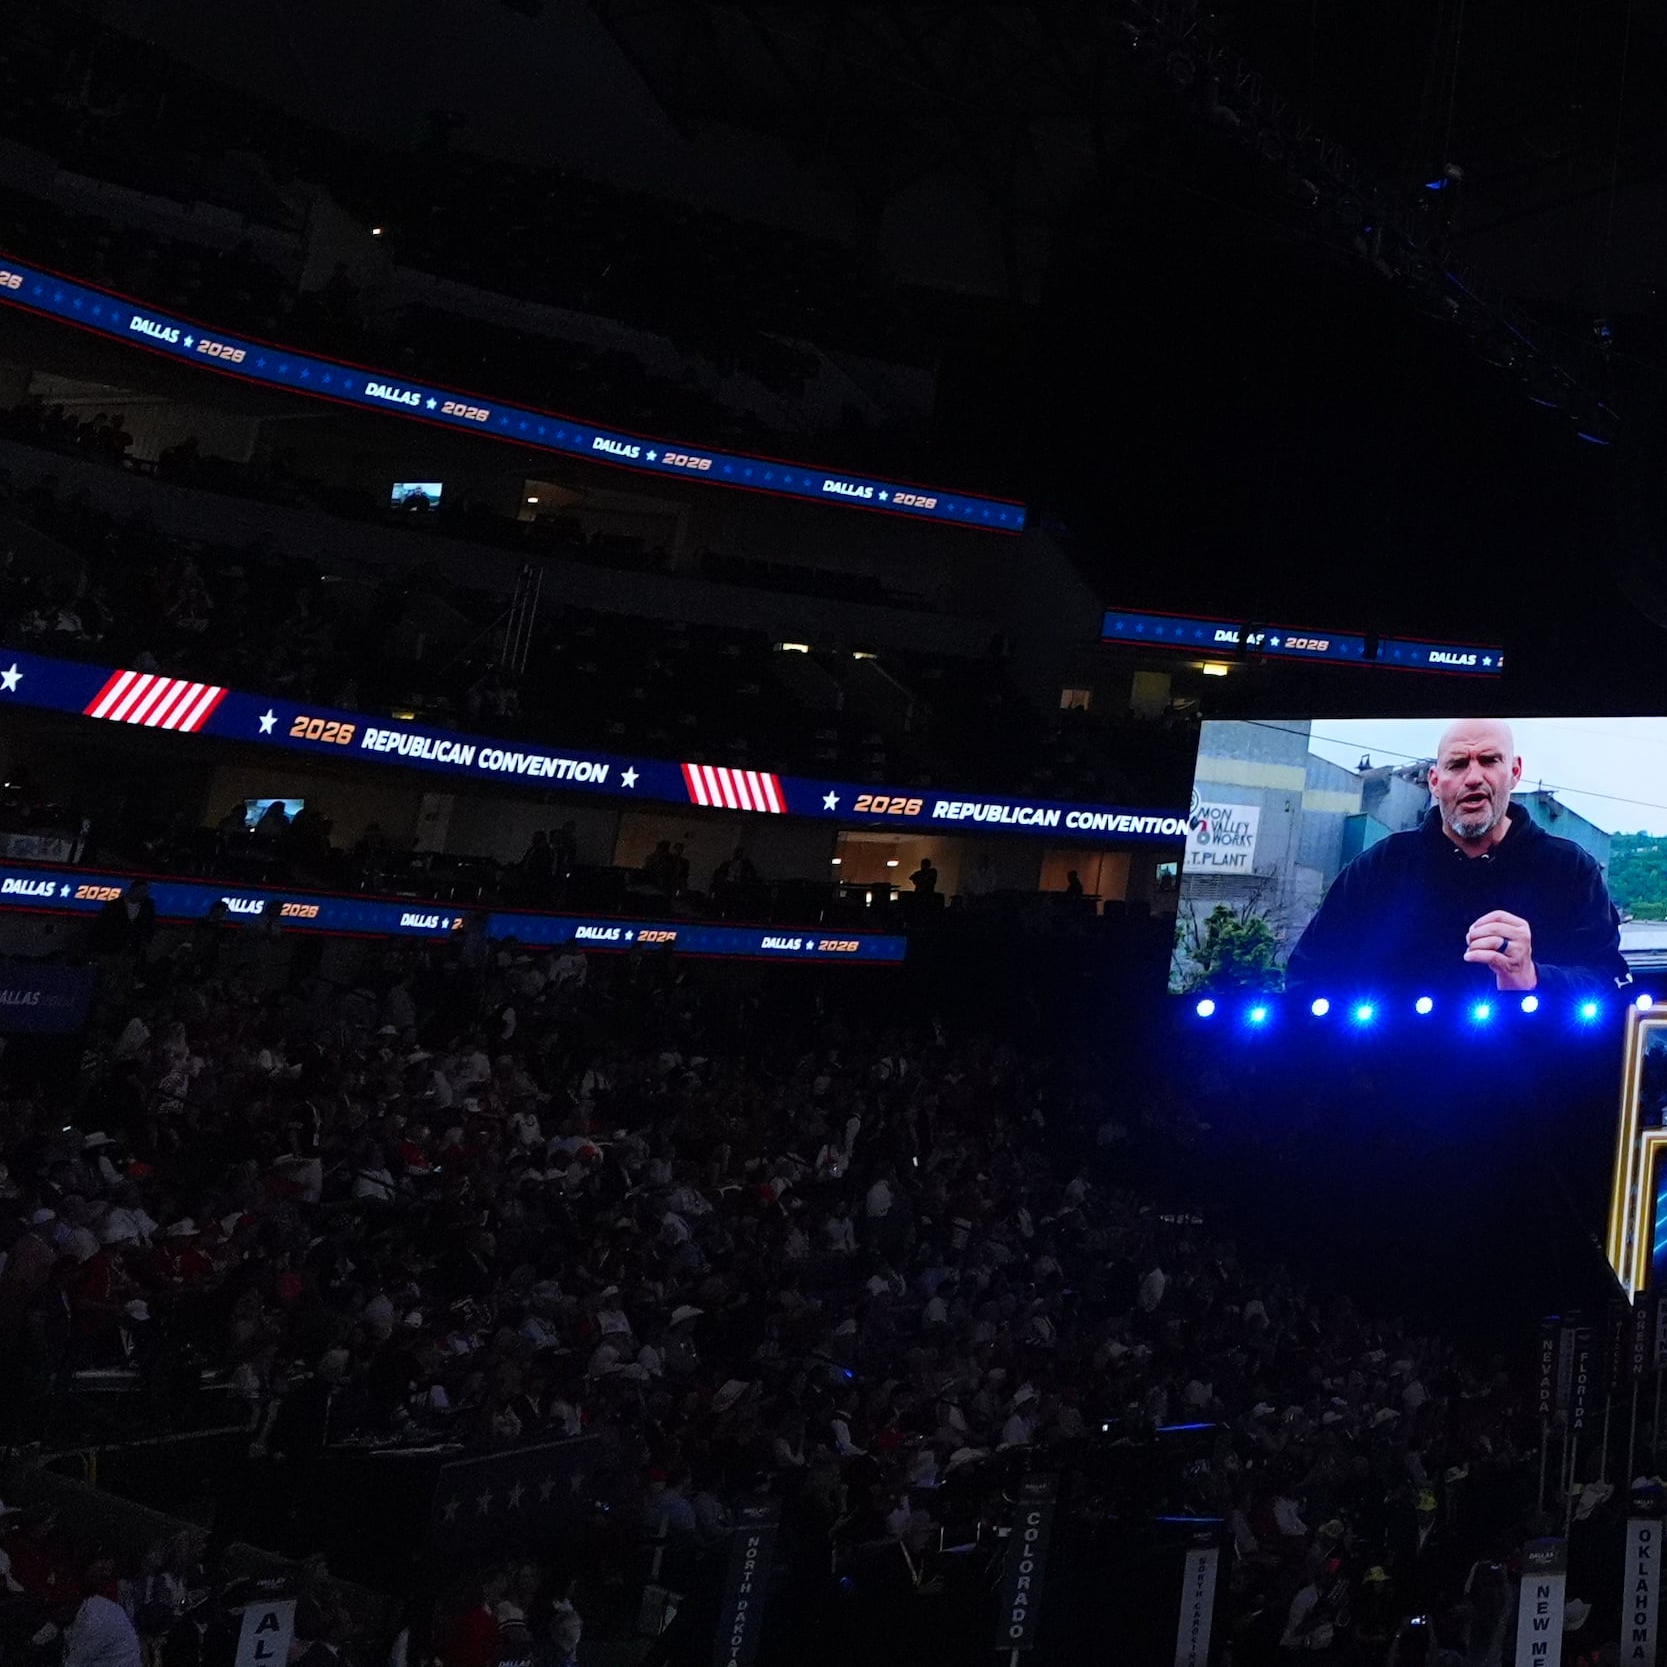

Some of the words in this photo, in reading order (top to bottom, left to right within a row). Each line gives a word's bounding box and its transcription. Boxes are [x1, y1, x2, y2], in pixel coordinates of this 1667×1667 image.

[130, 316, 180, 345] DALLAS
[197, 339, 246, 363] 2026
[365, 382, 421, 407] DALLAS
[441, 400, 490, 423] 2026
[592, 437, 640, 459] DALLAS
[662, 452, 712, 471] 2026
[822, 480, 874, 499] DALLAS
[893, 492, 937, 510] 2026
[1285, 637, 1330, 651] 2026
[1428, 651, 1477, 666] DALLAS
[289, 715, 355, 745] 2026
[361, 728, 476, 767] REPUBLICAN
[478, 747, 607, 785] CONVENTION
[854, 794, 924, 817] 2026
[932, 800, 1061, 829] REPUBLICAN
[1066, 811, 1189, 837] CONVENTION
[1199, 807, 1232, 820] MON
[1211, 820, 1250, 836] VALLEY
[1212, 834, 1253, 847] WORKS
[1, 878, 55, 897] DALLAS
[280, 903, 319, 918] 2026
[400, 913, 438, 930] DALLAS
[575, 926, 620, 942] DALLAS
[761, 937, 801, 950] DALLAS
[818, 940, 859, 952] 2026
[1632, 1309, 1647, 1373] OREGON
[1539, 1339, 1554, 1413] NEVADA
[1574, 1351, 1589, 1429] FLORIDA
[739, 1536, 760, 1594] NORTH
[1009, 1511, 1041, 1640] COLORADO
[1533, 1585, 1551, 1632] NEW
[1632, 1529, 1652, 1659] OKLAHOMA
[727, 1599, 749, 1667] DAKOTA
